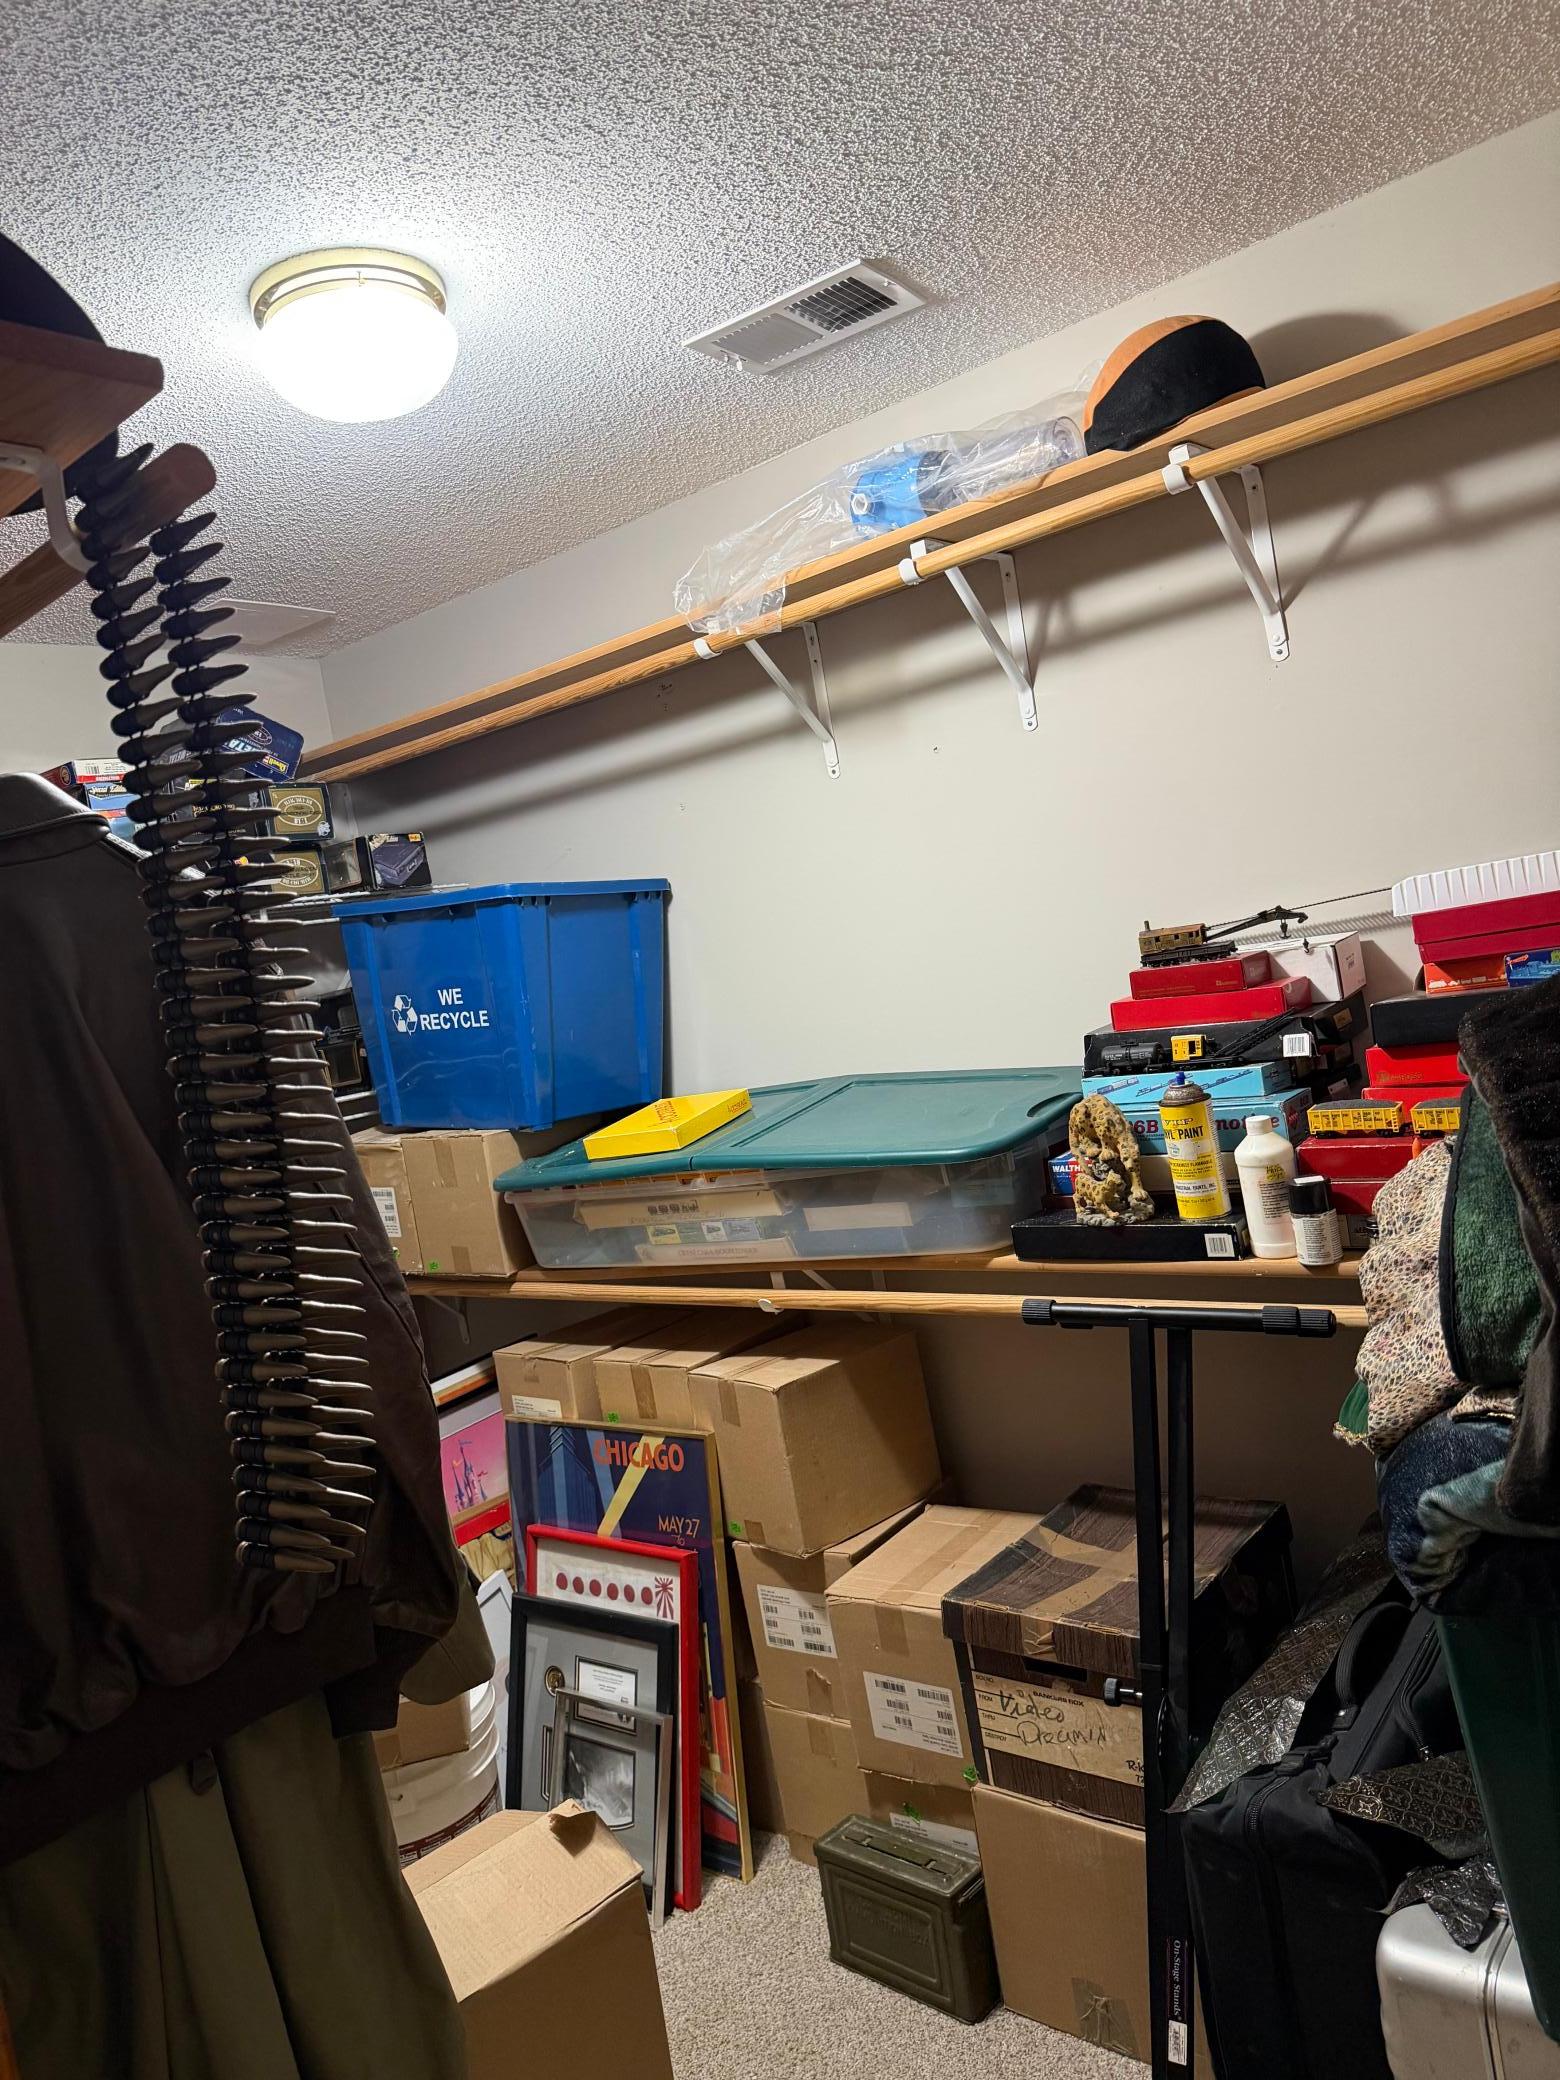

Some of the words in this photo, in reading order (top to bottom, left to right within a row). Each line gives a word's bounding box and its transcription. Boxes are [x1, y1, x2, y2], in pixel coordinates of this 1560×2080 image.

[437, 987, 464, 1006] WE
[420, 1010, 490, 1031] RECYCLE
[1179, 1125, 1205, 1140] PAINT
[1052, 1164, 1082, 1173] WALTH
[593, 1438, 685, 1473] CHICAGO
[658, 1514, 685, 1533] MAY
[686, 1518, 700, 1538] 27
[1172, 1940, 1181, 1982] On-Stage
[1173, 1983, 1182, 2016] Stands
